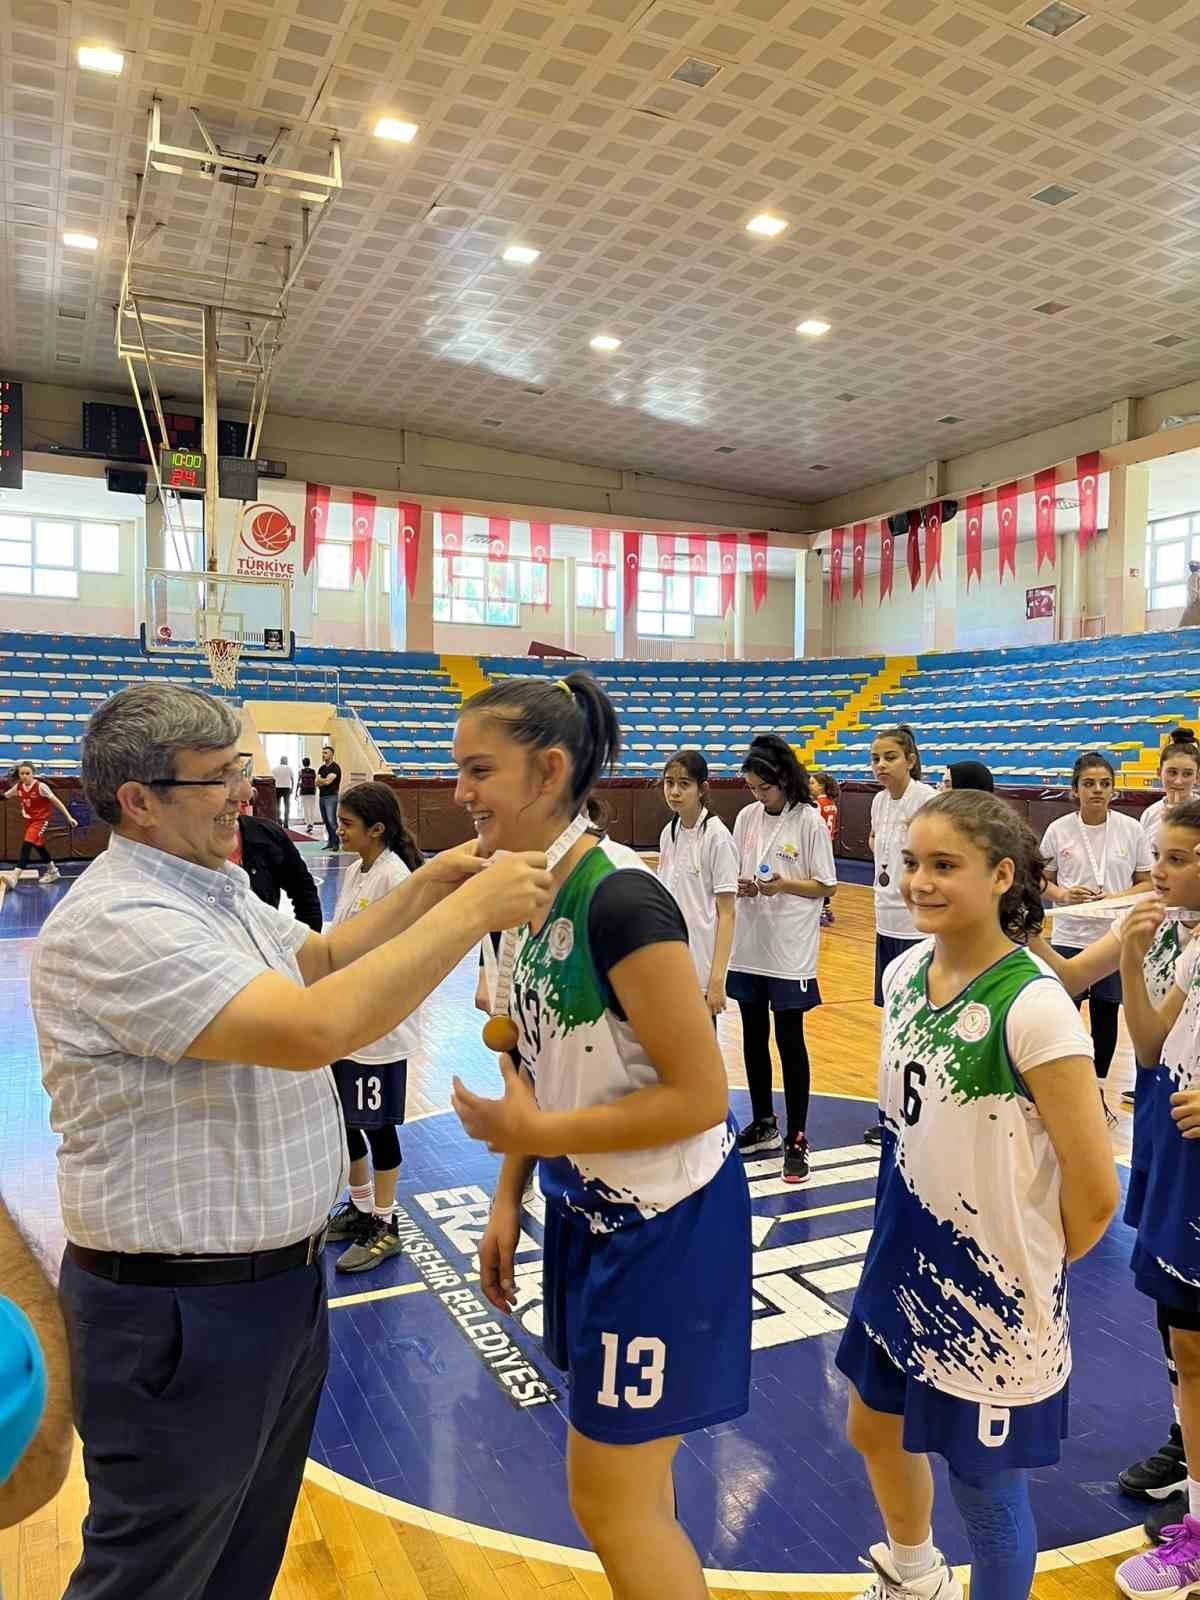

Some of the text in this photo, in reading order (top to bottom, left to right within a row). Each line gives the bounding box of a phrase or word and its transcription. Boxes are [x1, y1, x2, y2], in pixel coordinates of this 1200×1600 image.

[171, 469, 196, 486] 24
[172, 453, 201, 468] 10:00
[237, 556, 294, 573] TÜRKİYE
[355, 1076, 381, 1110] 13
[903, 1061, 927, 1127] 6
[392, 1199, 462, 1290] ÜYÜKŞEHİR
[597, 1331, 666, 1409] 13
